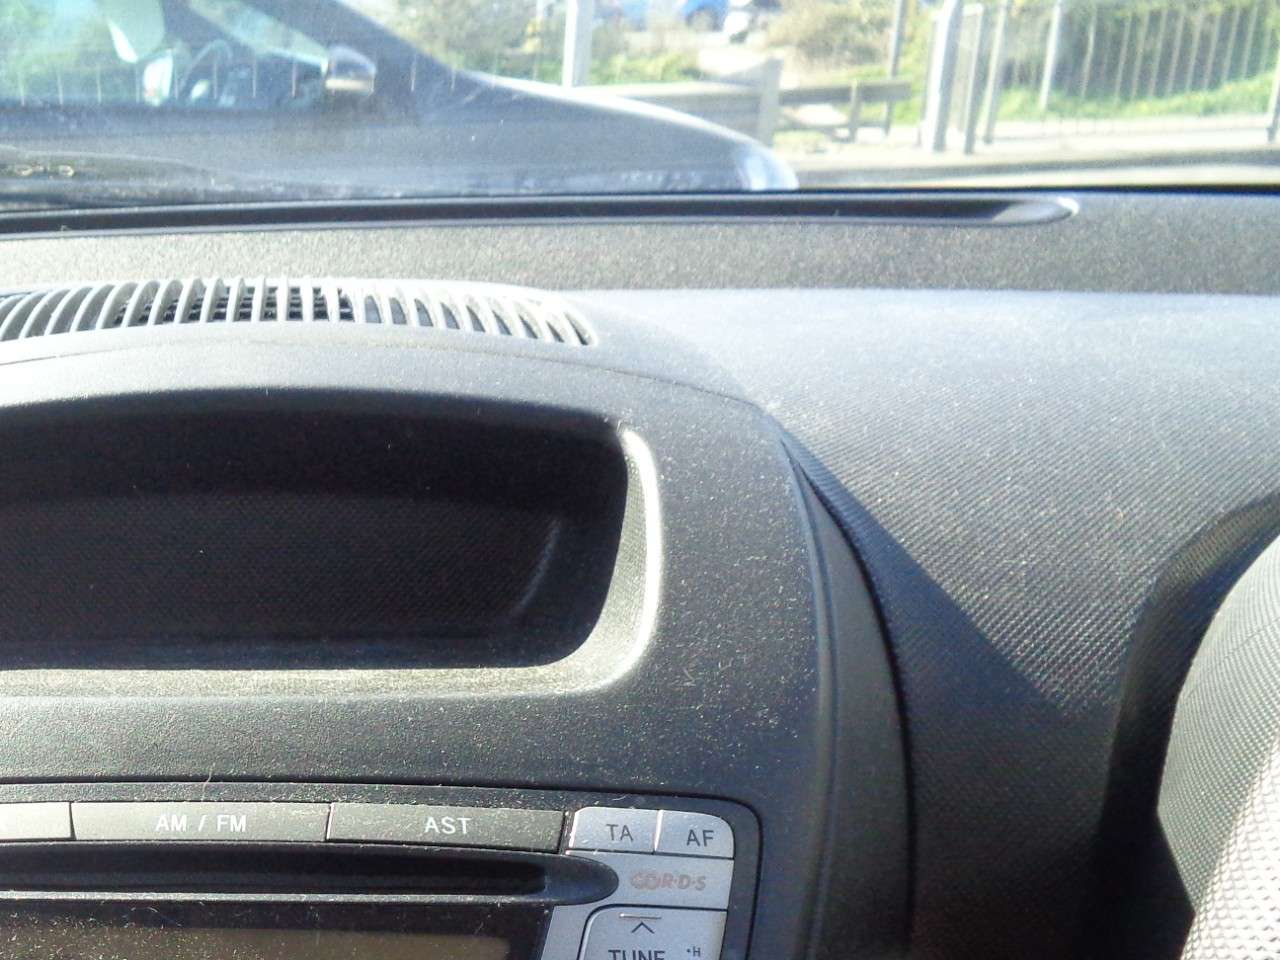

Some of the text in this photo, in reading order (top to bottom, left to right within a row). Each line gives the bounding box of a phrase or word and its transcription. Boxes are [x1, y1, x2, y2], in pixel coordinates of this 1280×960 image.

[155, 814, 187, 832] AM
[216, 814, 246, 832] FM
[424, 816, 470, 834] AST
[606, 823, 634, 841] TA
[686, 829, 714, 847] AF
